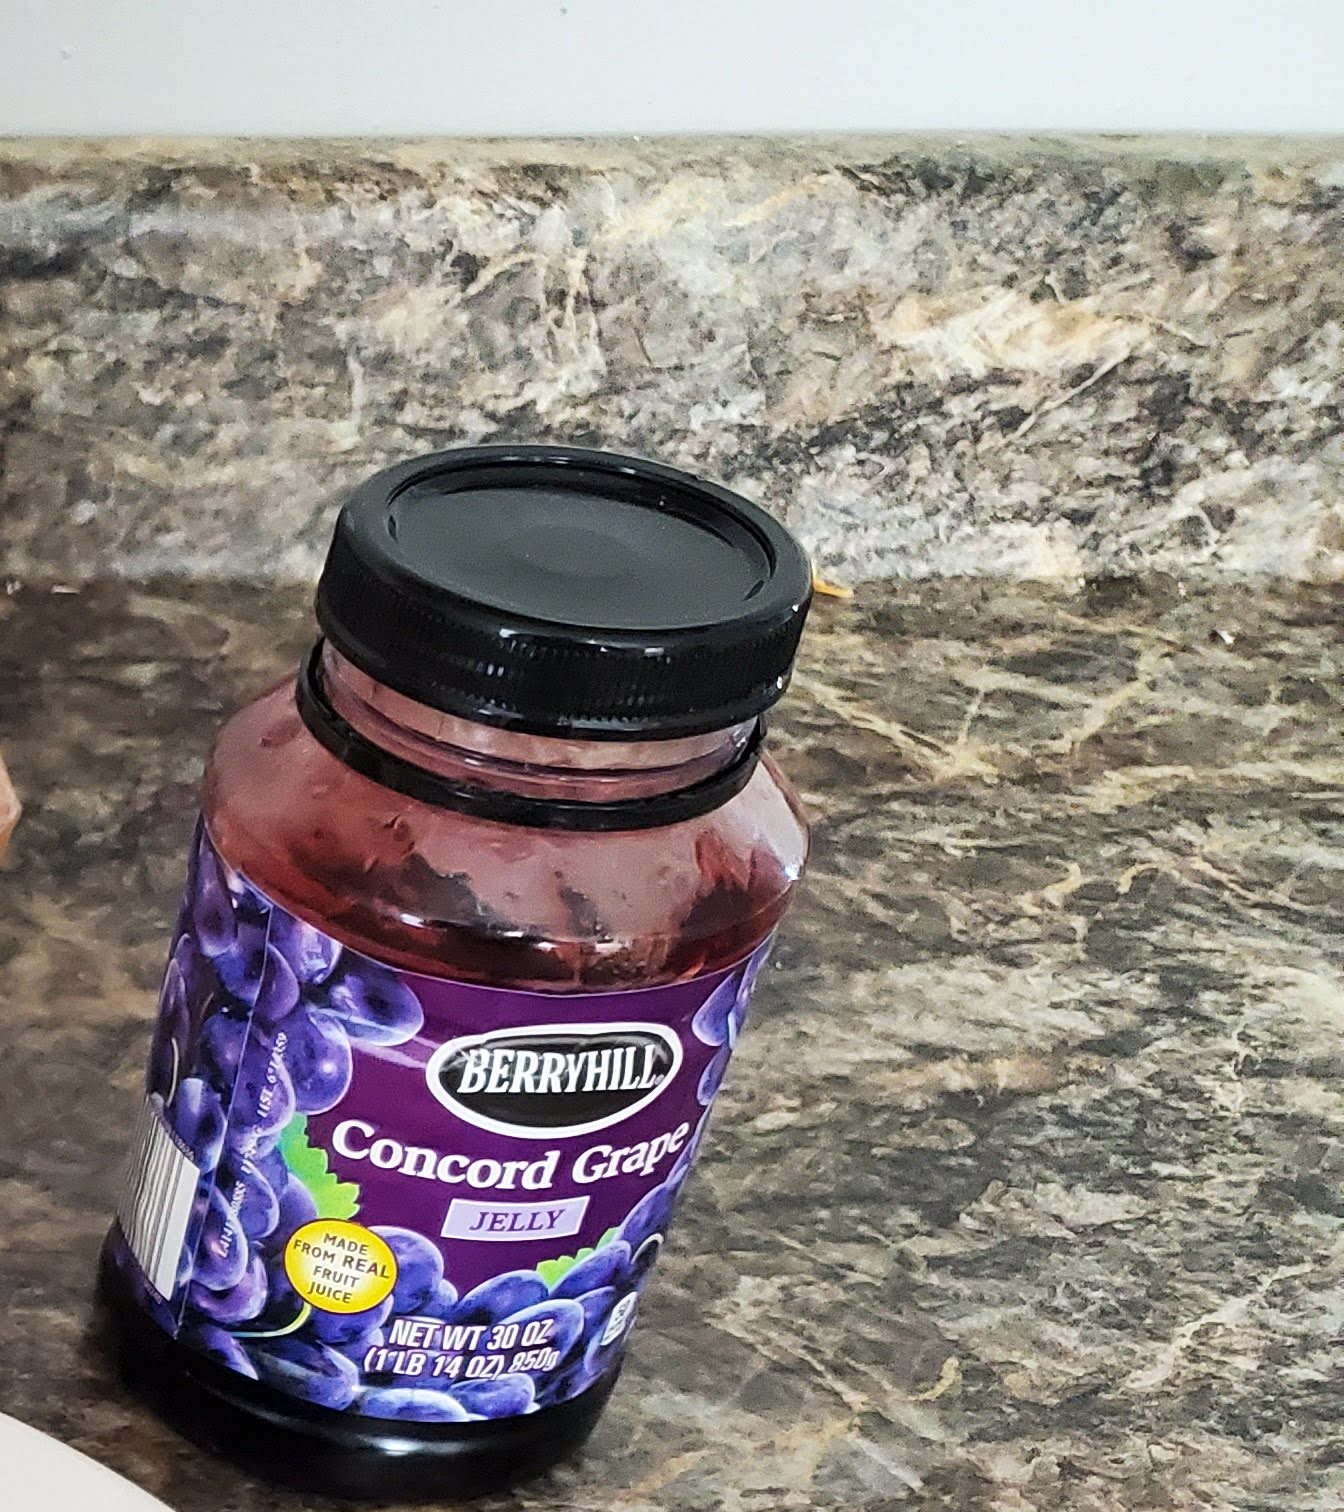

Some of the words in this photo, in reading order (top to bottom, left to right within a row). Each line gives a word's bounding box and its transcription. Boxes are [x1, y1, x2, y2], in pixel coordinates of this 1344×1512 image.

[456, 1044, 661, 1095] BERRYHILL
[332, 1119, 560, 1191] Concord
[572, 1121, 690, 1185] Grape
[468, 1208, 567, 1233] JELLY
[293, 1239, 337, 1267] FROM
[342, 1255, 390, 1279] REAL
[323, 1233, 369, 1257] MADE
[307, 1281, 353, 1304] JUICE
[313, 1265, 360, 1289] FRUIT
[389, 1319, 440, 1349] NET
[443, 1324, 481, 1351] WT
[486, 1323, 517, 1350] 30
[523, 1318, 554, 1347] OZ
[392, 1351, 424, 1376] LB
[434, 1354, 459, 1378] 14
[465, 1355, 505, 1381] OZ)
[508, 1347, 561, 1374] 850g
